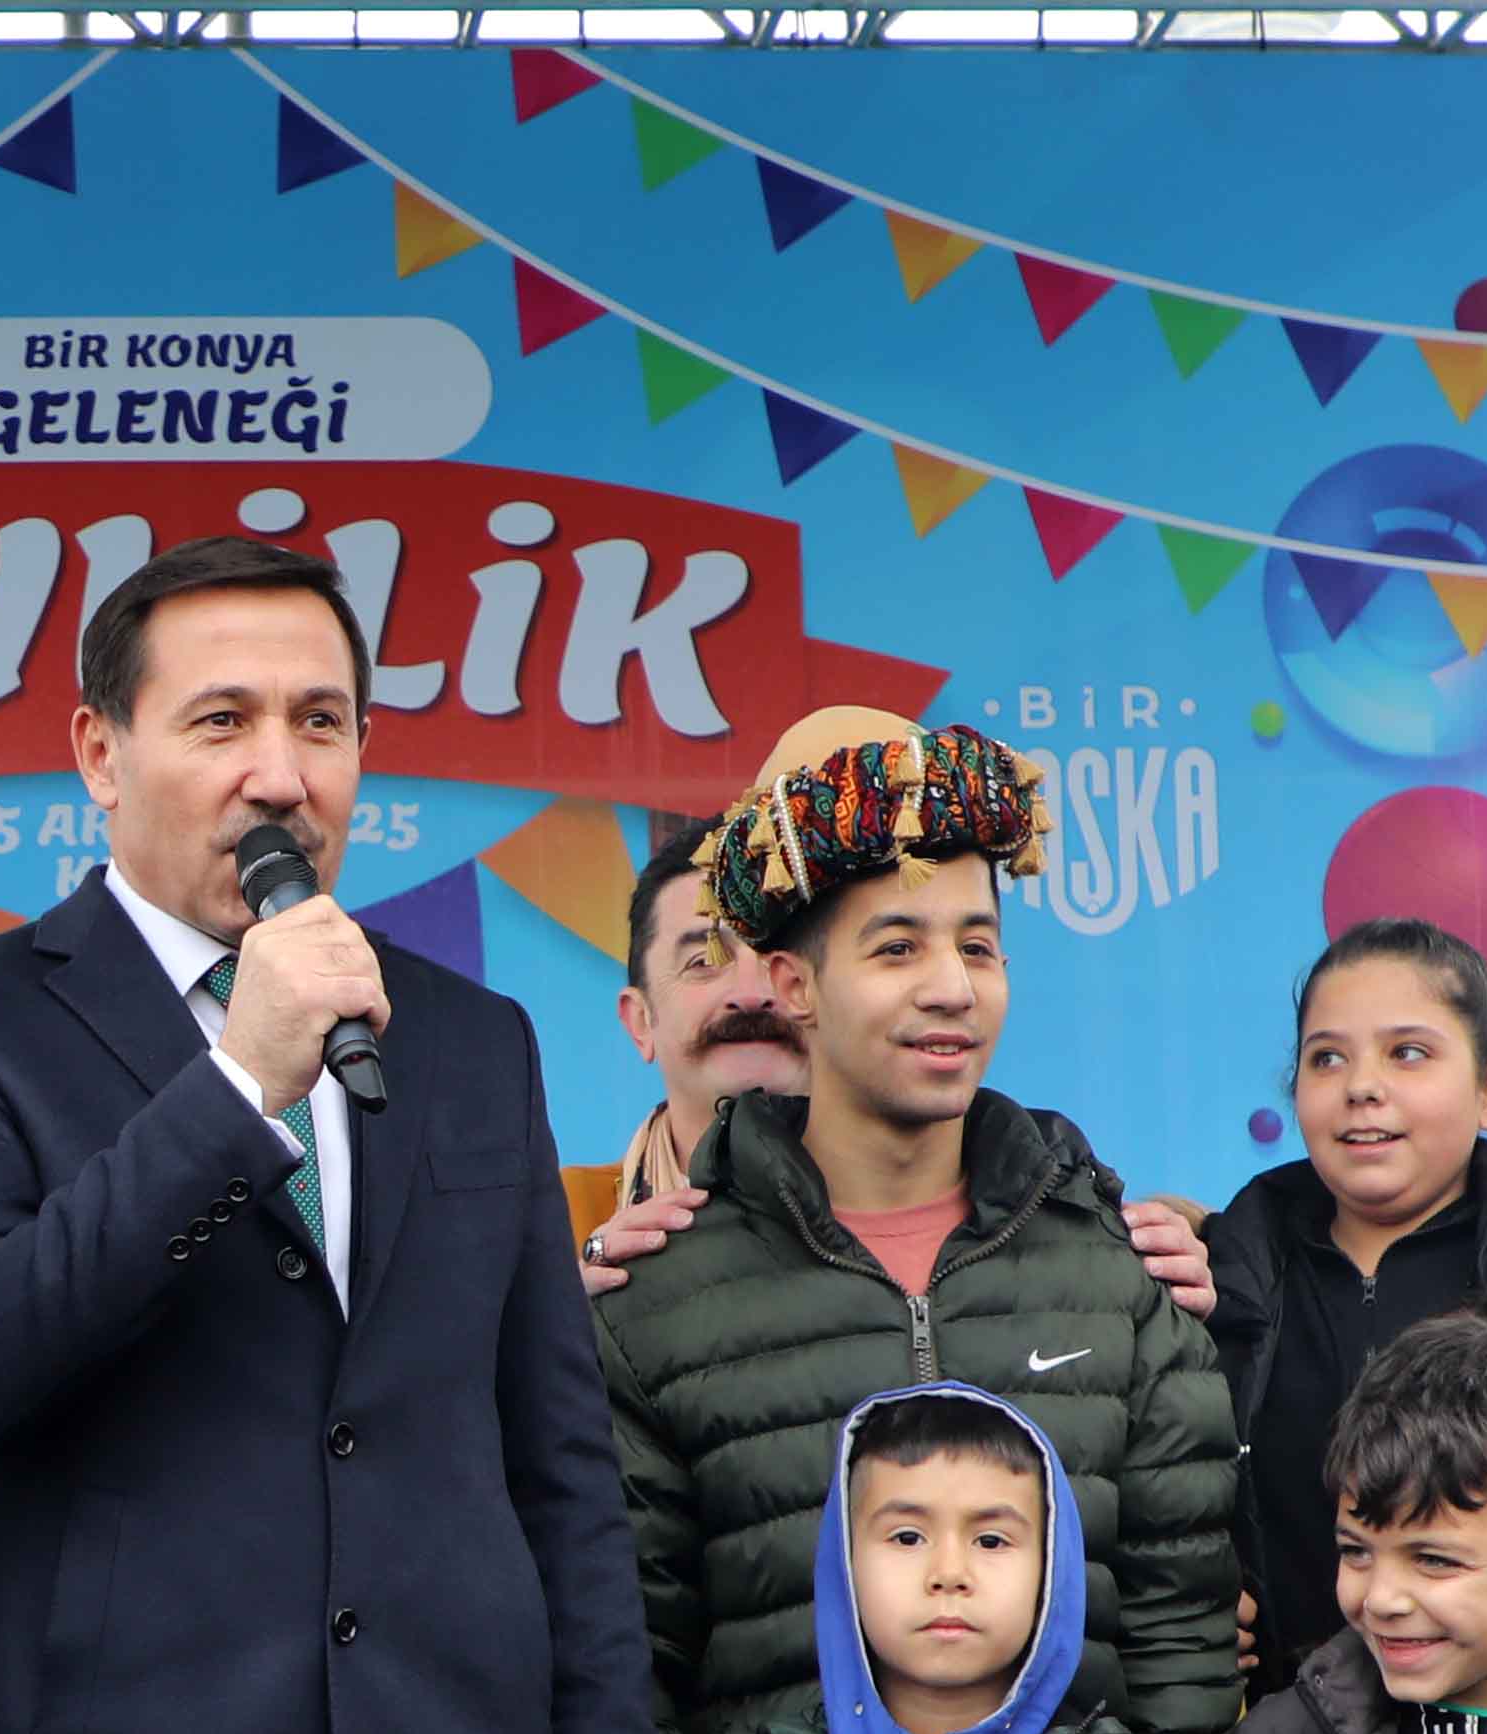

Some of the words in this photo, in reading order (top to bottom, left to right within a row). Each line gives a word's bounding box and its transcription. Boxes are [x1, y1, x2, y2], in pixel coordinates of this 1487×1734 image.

[126, 333, 297, 374] KONYA
[348, 801, 420, 851] 25
[995, 746, 1220, 937] AŞKA
